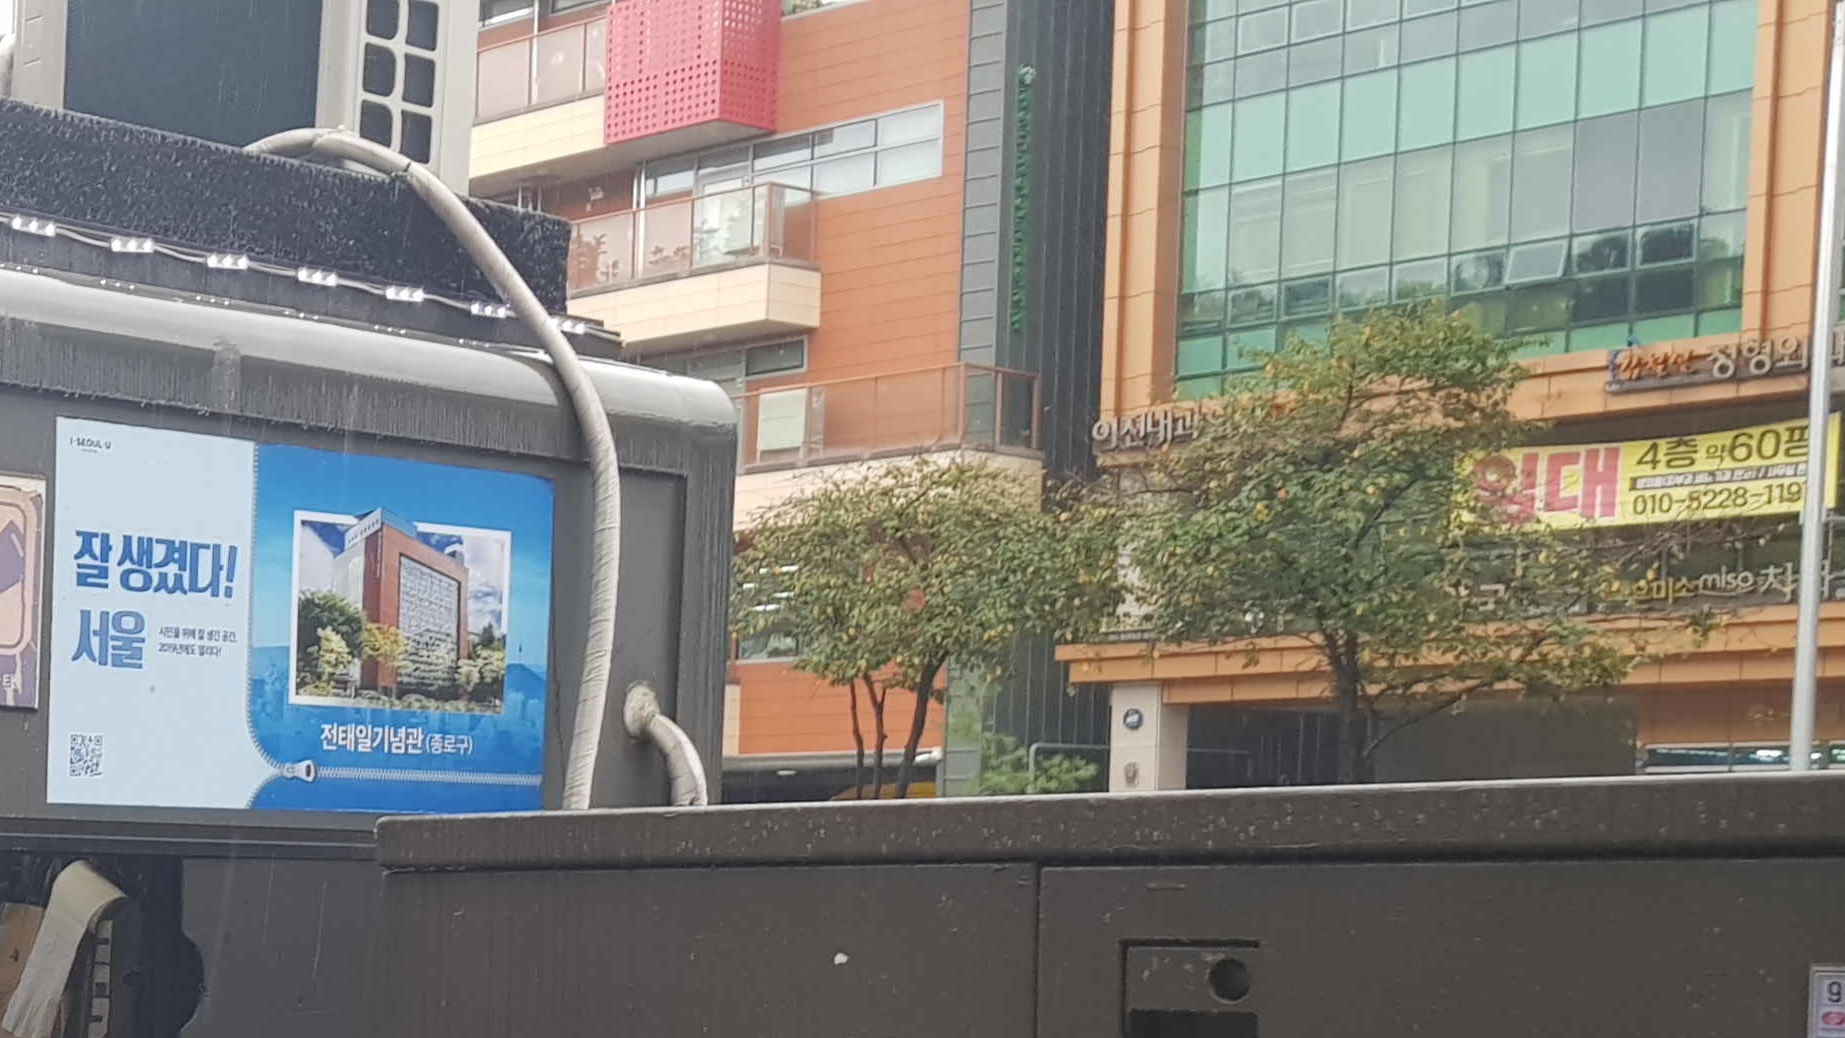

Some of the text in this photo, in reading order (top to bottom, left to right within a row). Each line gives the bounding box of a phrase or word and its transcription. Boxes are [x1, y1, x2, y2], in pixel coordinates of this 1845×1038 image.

[1636, 436, 1699, 470] 4층
[1632, 480, 1809, 516] 010-5228-119
[70, 608, 147, 670] 서울
[320, 722, 474, 756] 전태일기념관 (종로구)
